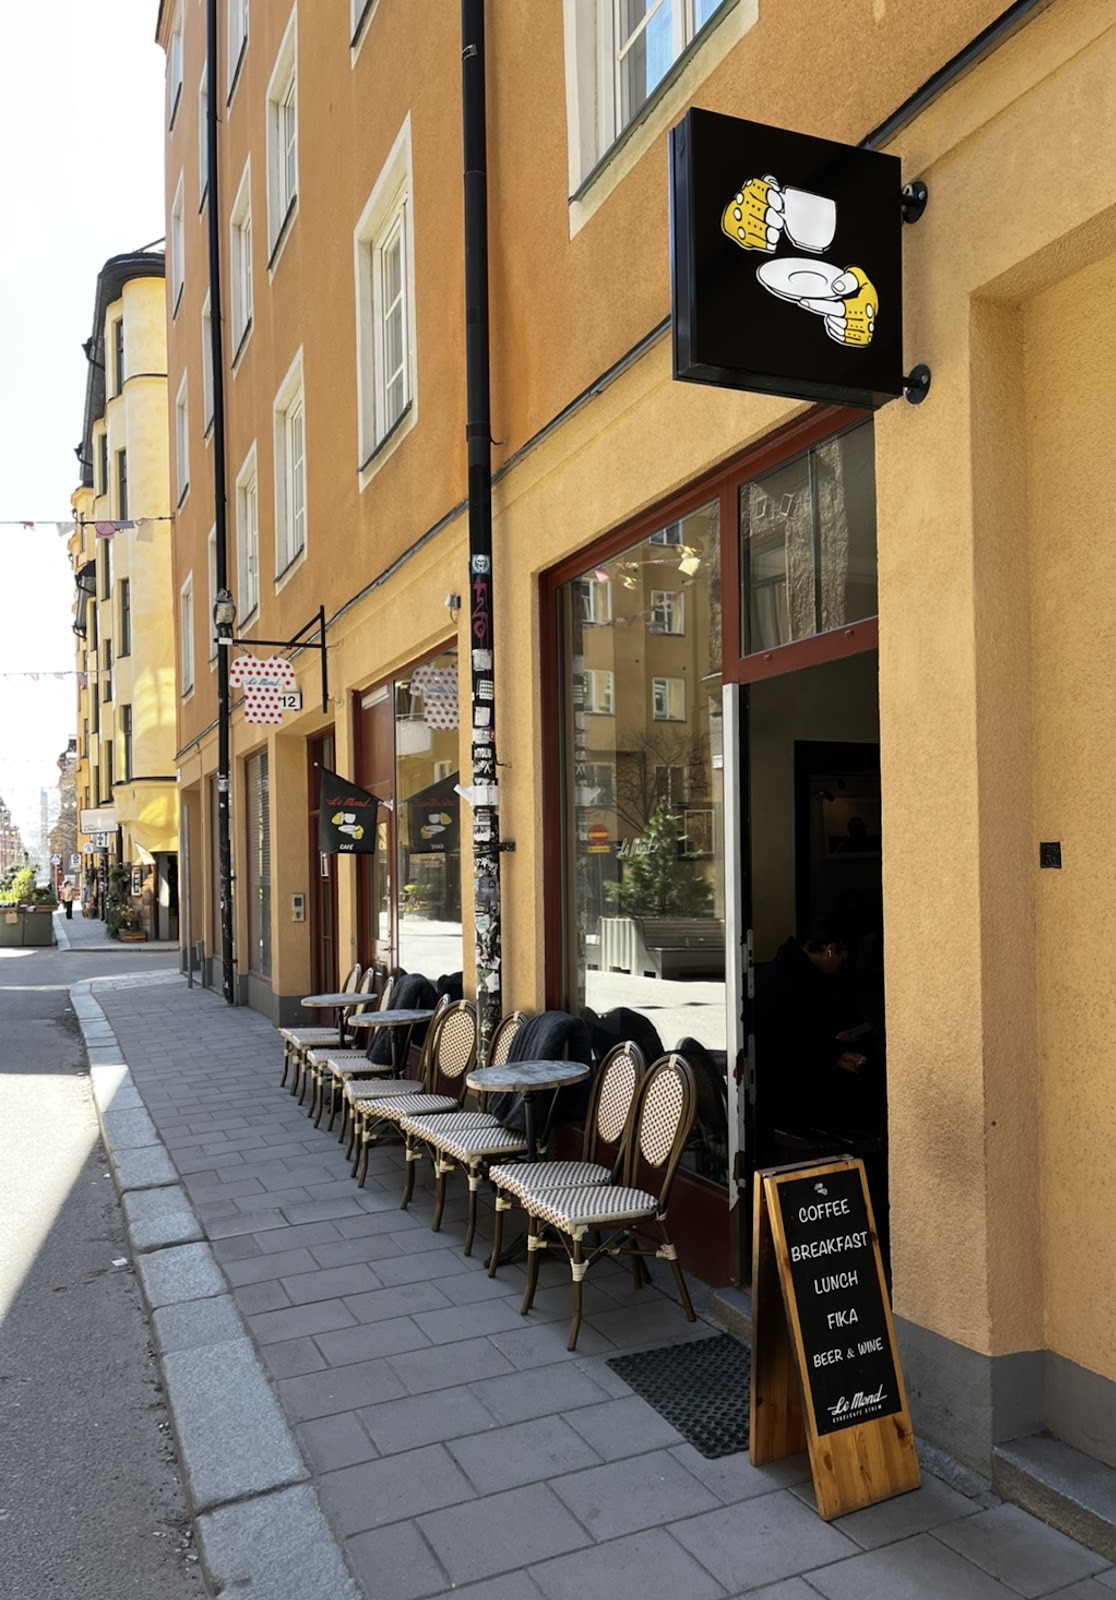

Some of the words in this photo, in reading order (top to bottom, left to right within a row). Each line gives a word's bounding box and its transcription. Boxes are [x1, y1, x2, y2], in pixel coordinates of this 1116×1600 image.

[281, 696, 296, 708] 12
[327, 796, 343, 806] Le
[343, 797, 372, 807] Mond
[798, 1198, 850, 1223] COFFEE
[791, 1231, 868, 1262] BREAKFAST
[814, 1270, 859, 1295] LUNCH
[827, 1308, 858, 1330] FIKA
[813, 1348, 843, 1368] BEER
[846, 1347, 855, 1359] &
[857, 1337, 884, 1355] WINE
[827, 1396, 850, 1416] Le
[851, 1384, 888, 1410] Mond
